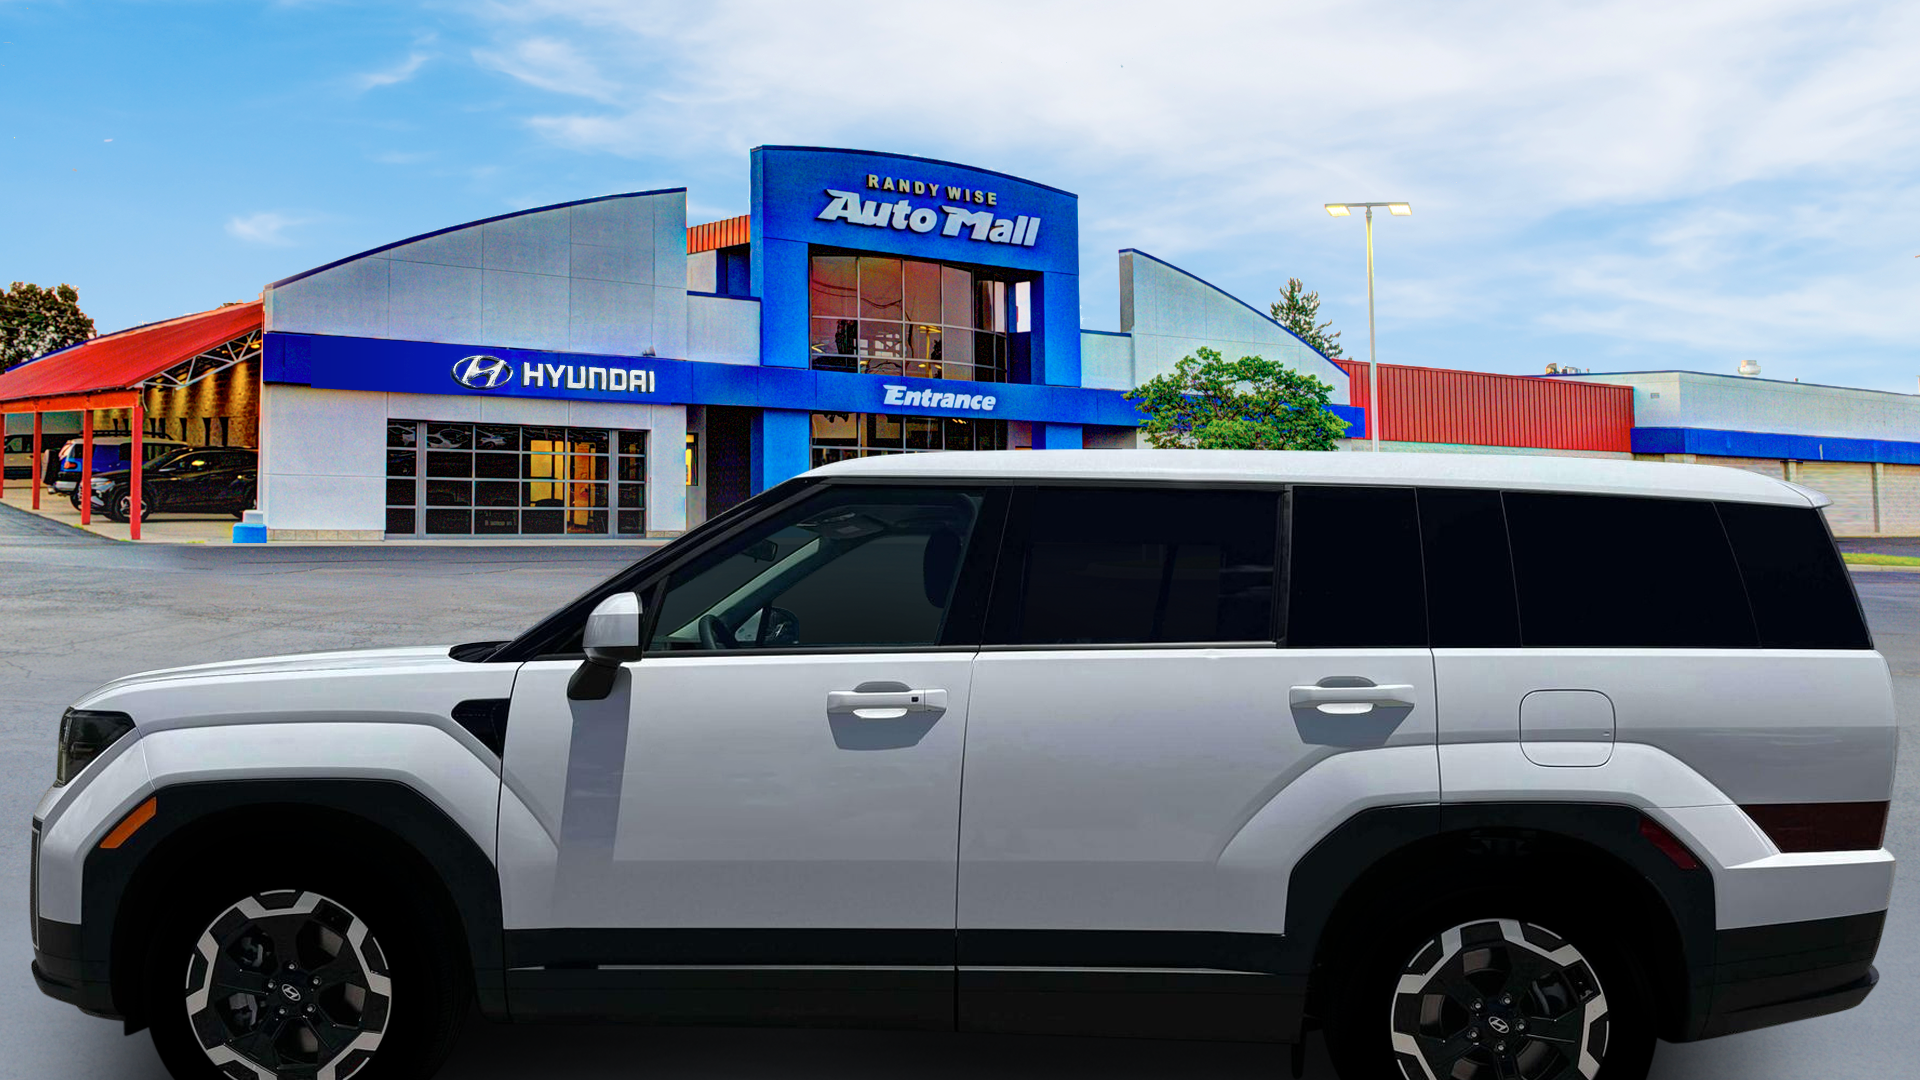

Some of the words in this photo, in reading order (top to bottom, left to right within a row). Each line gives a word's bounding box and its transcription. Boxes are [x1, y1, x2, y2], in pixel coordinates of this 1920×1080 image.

[867, 174, 940, 197] RANDY
[947, 186, 997, 206] WISE
[817, 188, 938, 233] Auto
[941, 205, 1041, 247] Mall
[523, 362, 655, 393] HYUNDAI
[883, 384, 996, 411] Entrance
